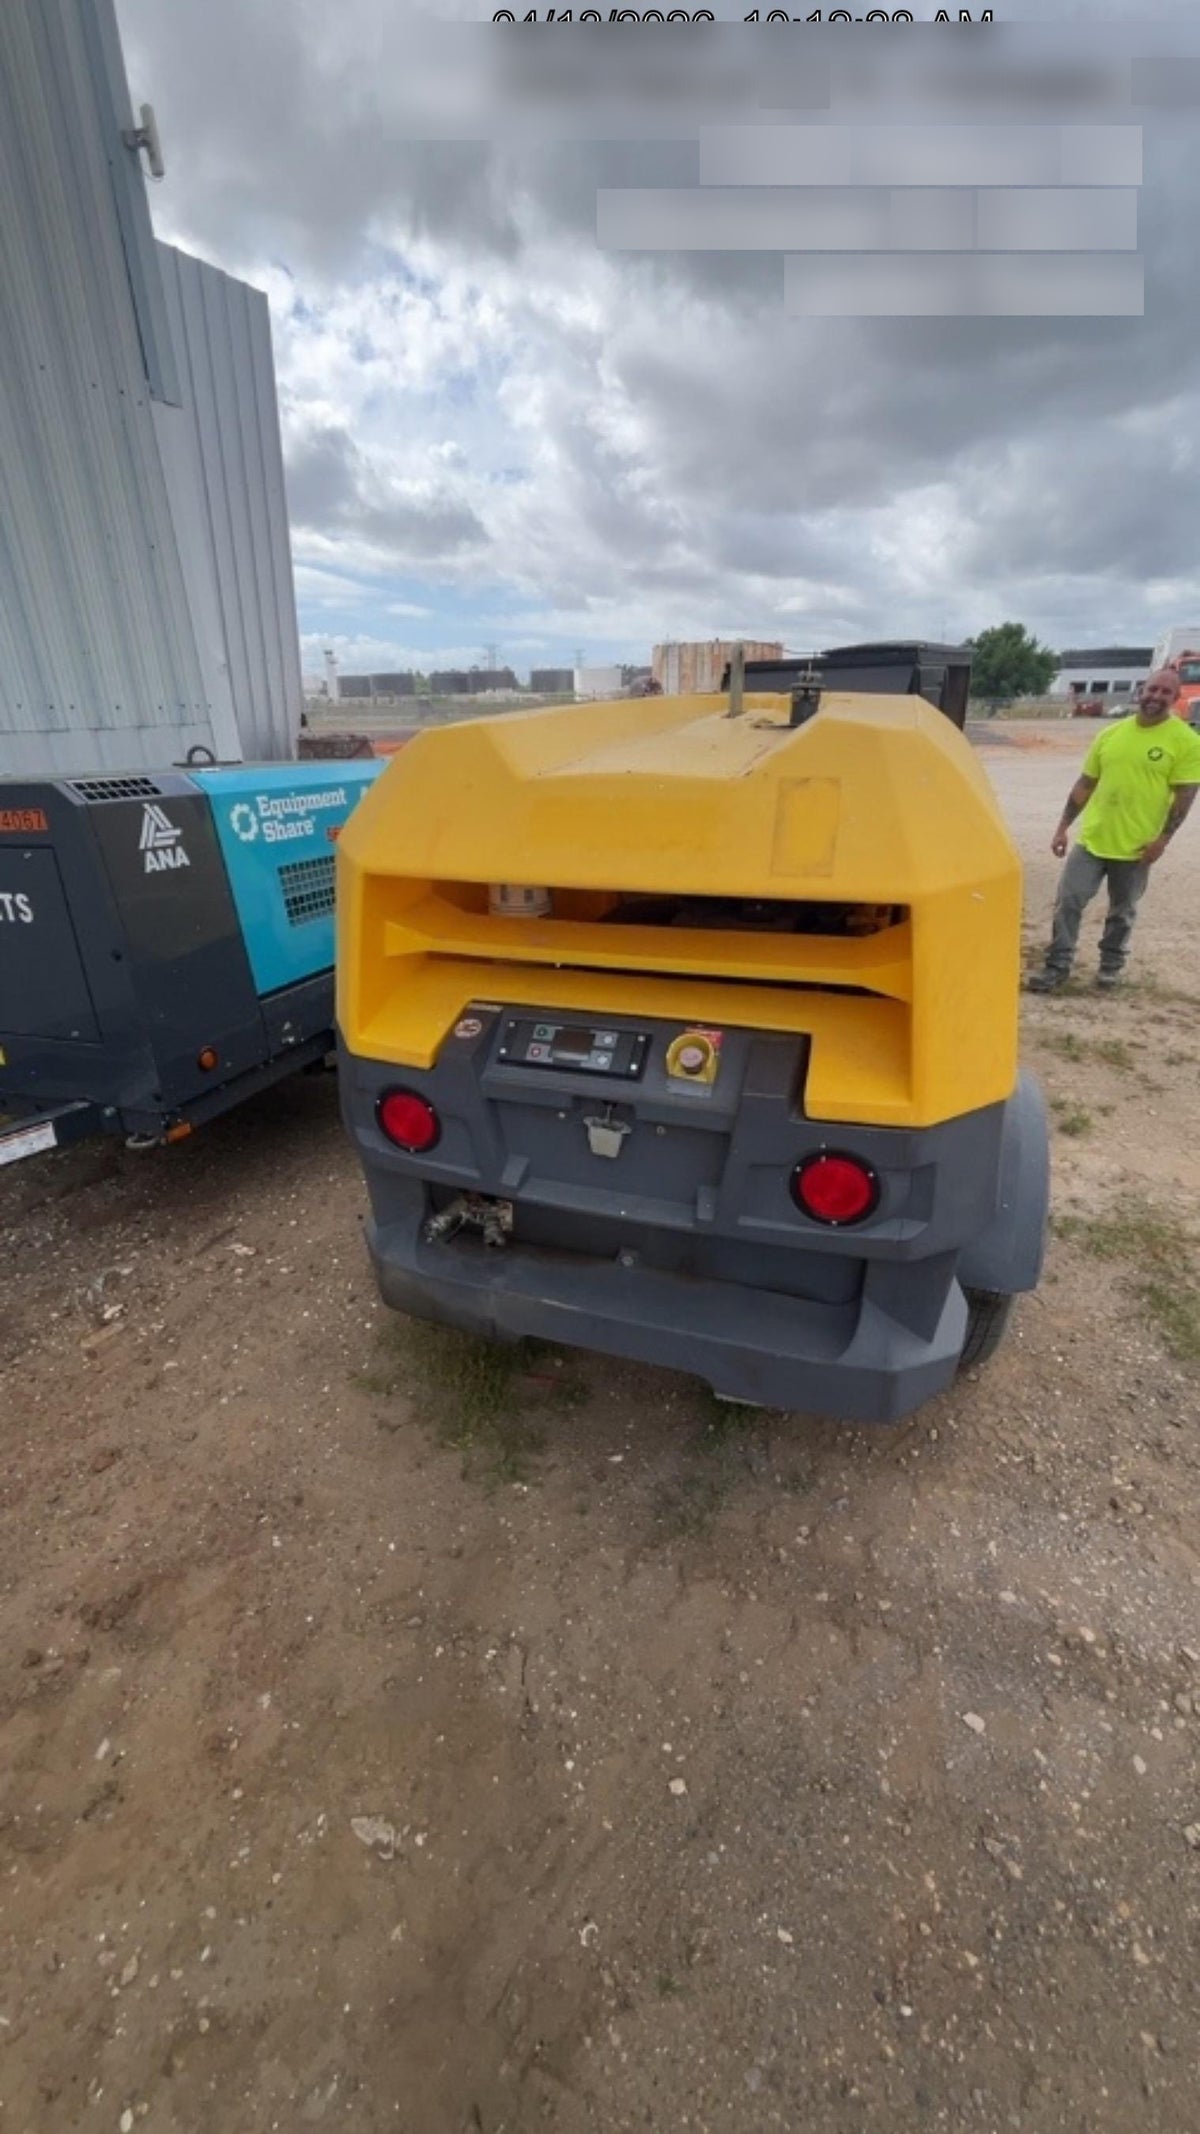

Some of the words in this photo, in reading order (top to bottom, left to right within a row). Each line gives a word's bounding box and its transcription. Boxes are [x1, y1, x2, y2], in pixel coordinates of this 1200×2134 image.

[256, 787, 347, 818] Equipment
[262, 819, 314, 843] Share
[144, 846, 191, 873] ANA
[0, 893, 34, 923] TS
